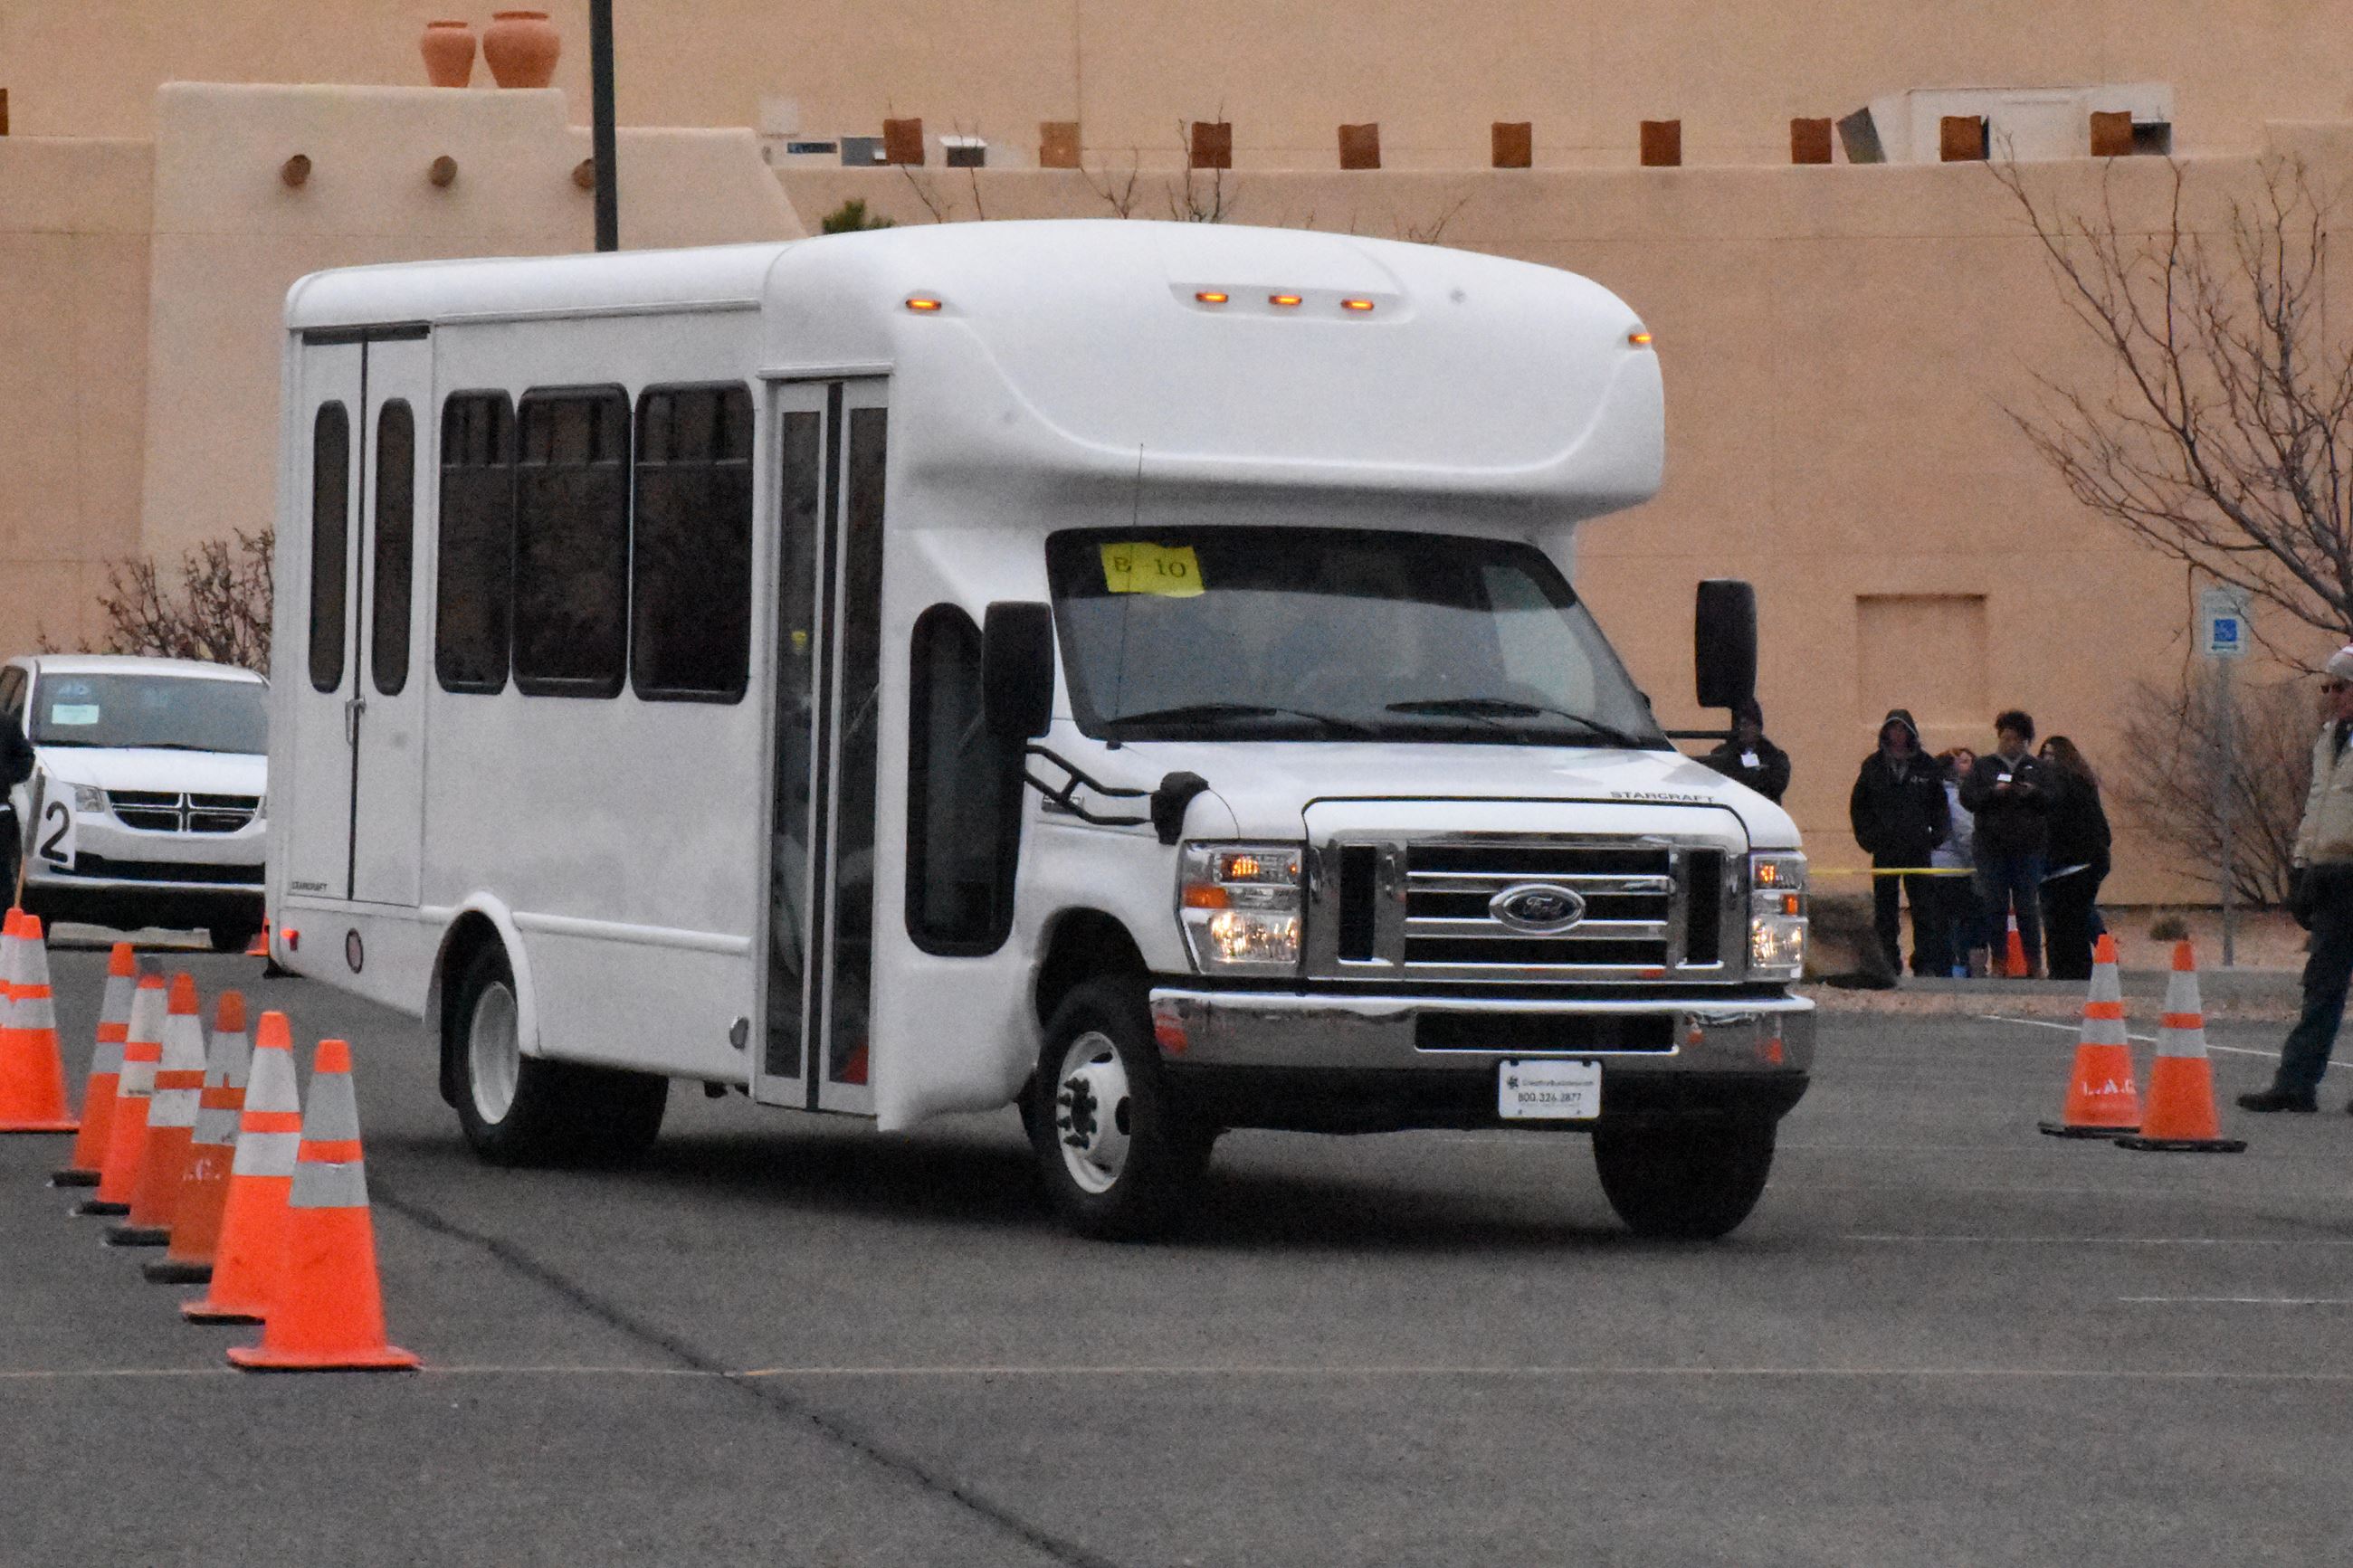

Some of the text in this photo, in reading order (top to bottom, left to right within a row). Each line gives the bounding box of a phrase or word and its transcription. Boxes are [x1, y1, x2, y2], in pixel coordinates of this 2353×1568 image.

[1610, 791, 1716, 804] STARCRAFT
[40, 801, 70, 863] 2
[1522, 896, 1563, 916] Ford
